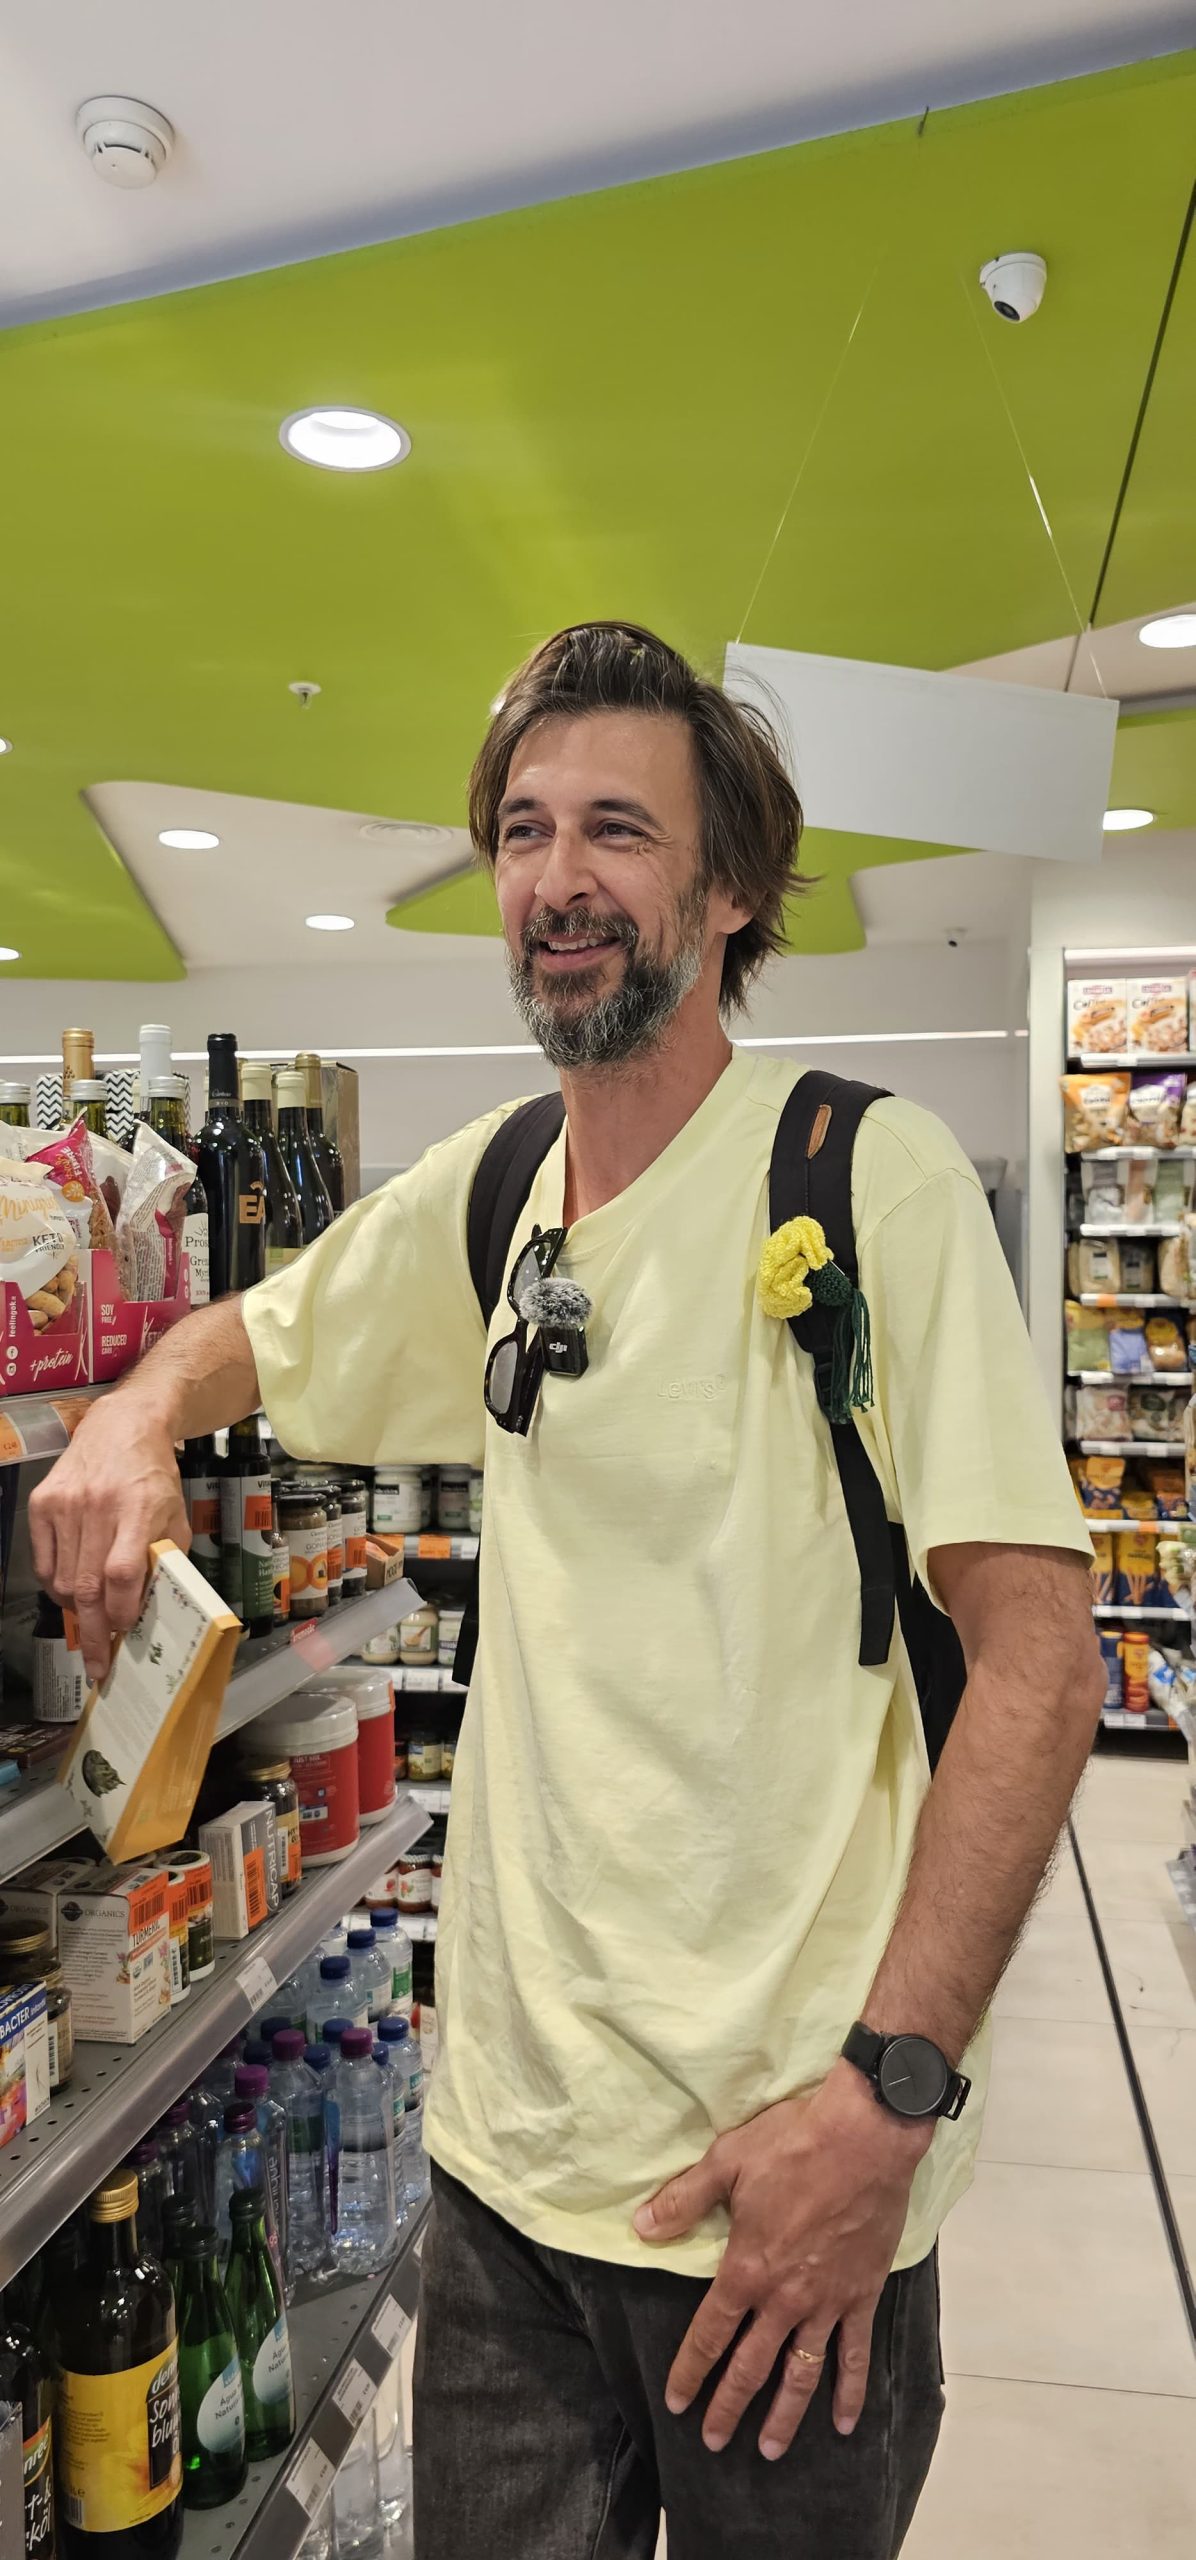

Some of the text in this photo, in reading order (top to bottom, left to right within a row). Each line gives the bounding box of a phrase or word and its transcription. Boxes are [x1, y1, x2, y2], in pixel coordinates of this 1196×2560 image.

[32, 1232, 64, 1247] KETO
[101, 1304, 113, 1315] SOY
[101, 1335, 127, 1346] REDUCED
[549, 1341, 568, 1353] dji
[265, 1809, 280, 1908] NUTRICAP
[84, 1909, 126, 1919] ORGANICS
